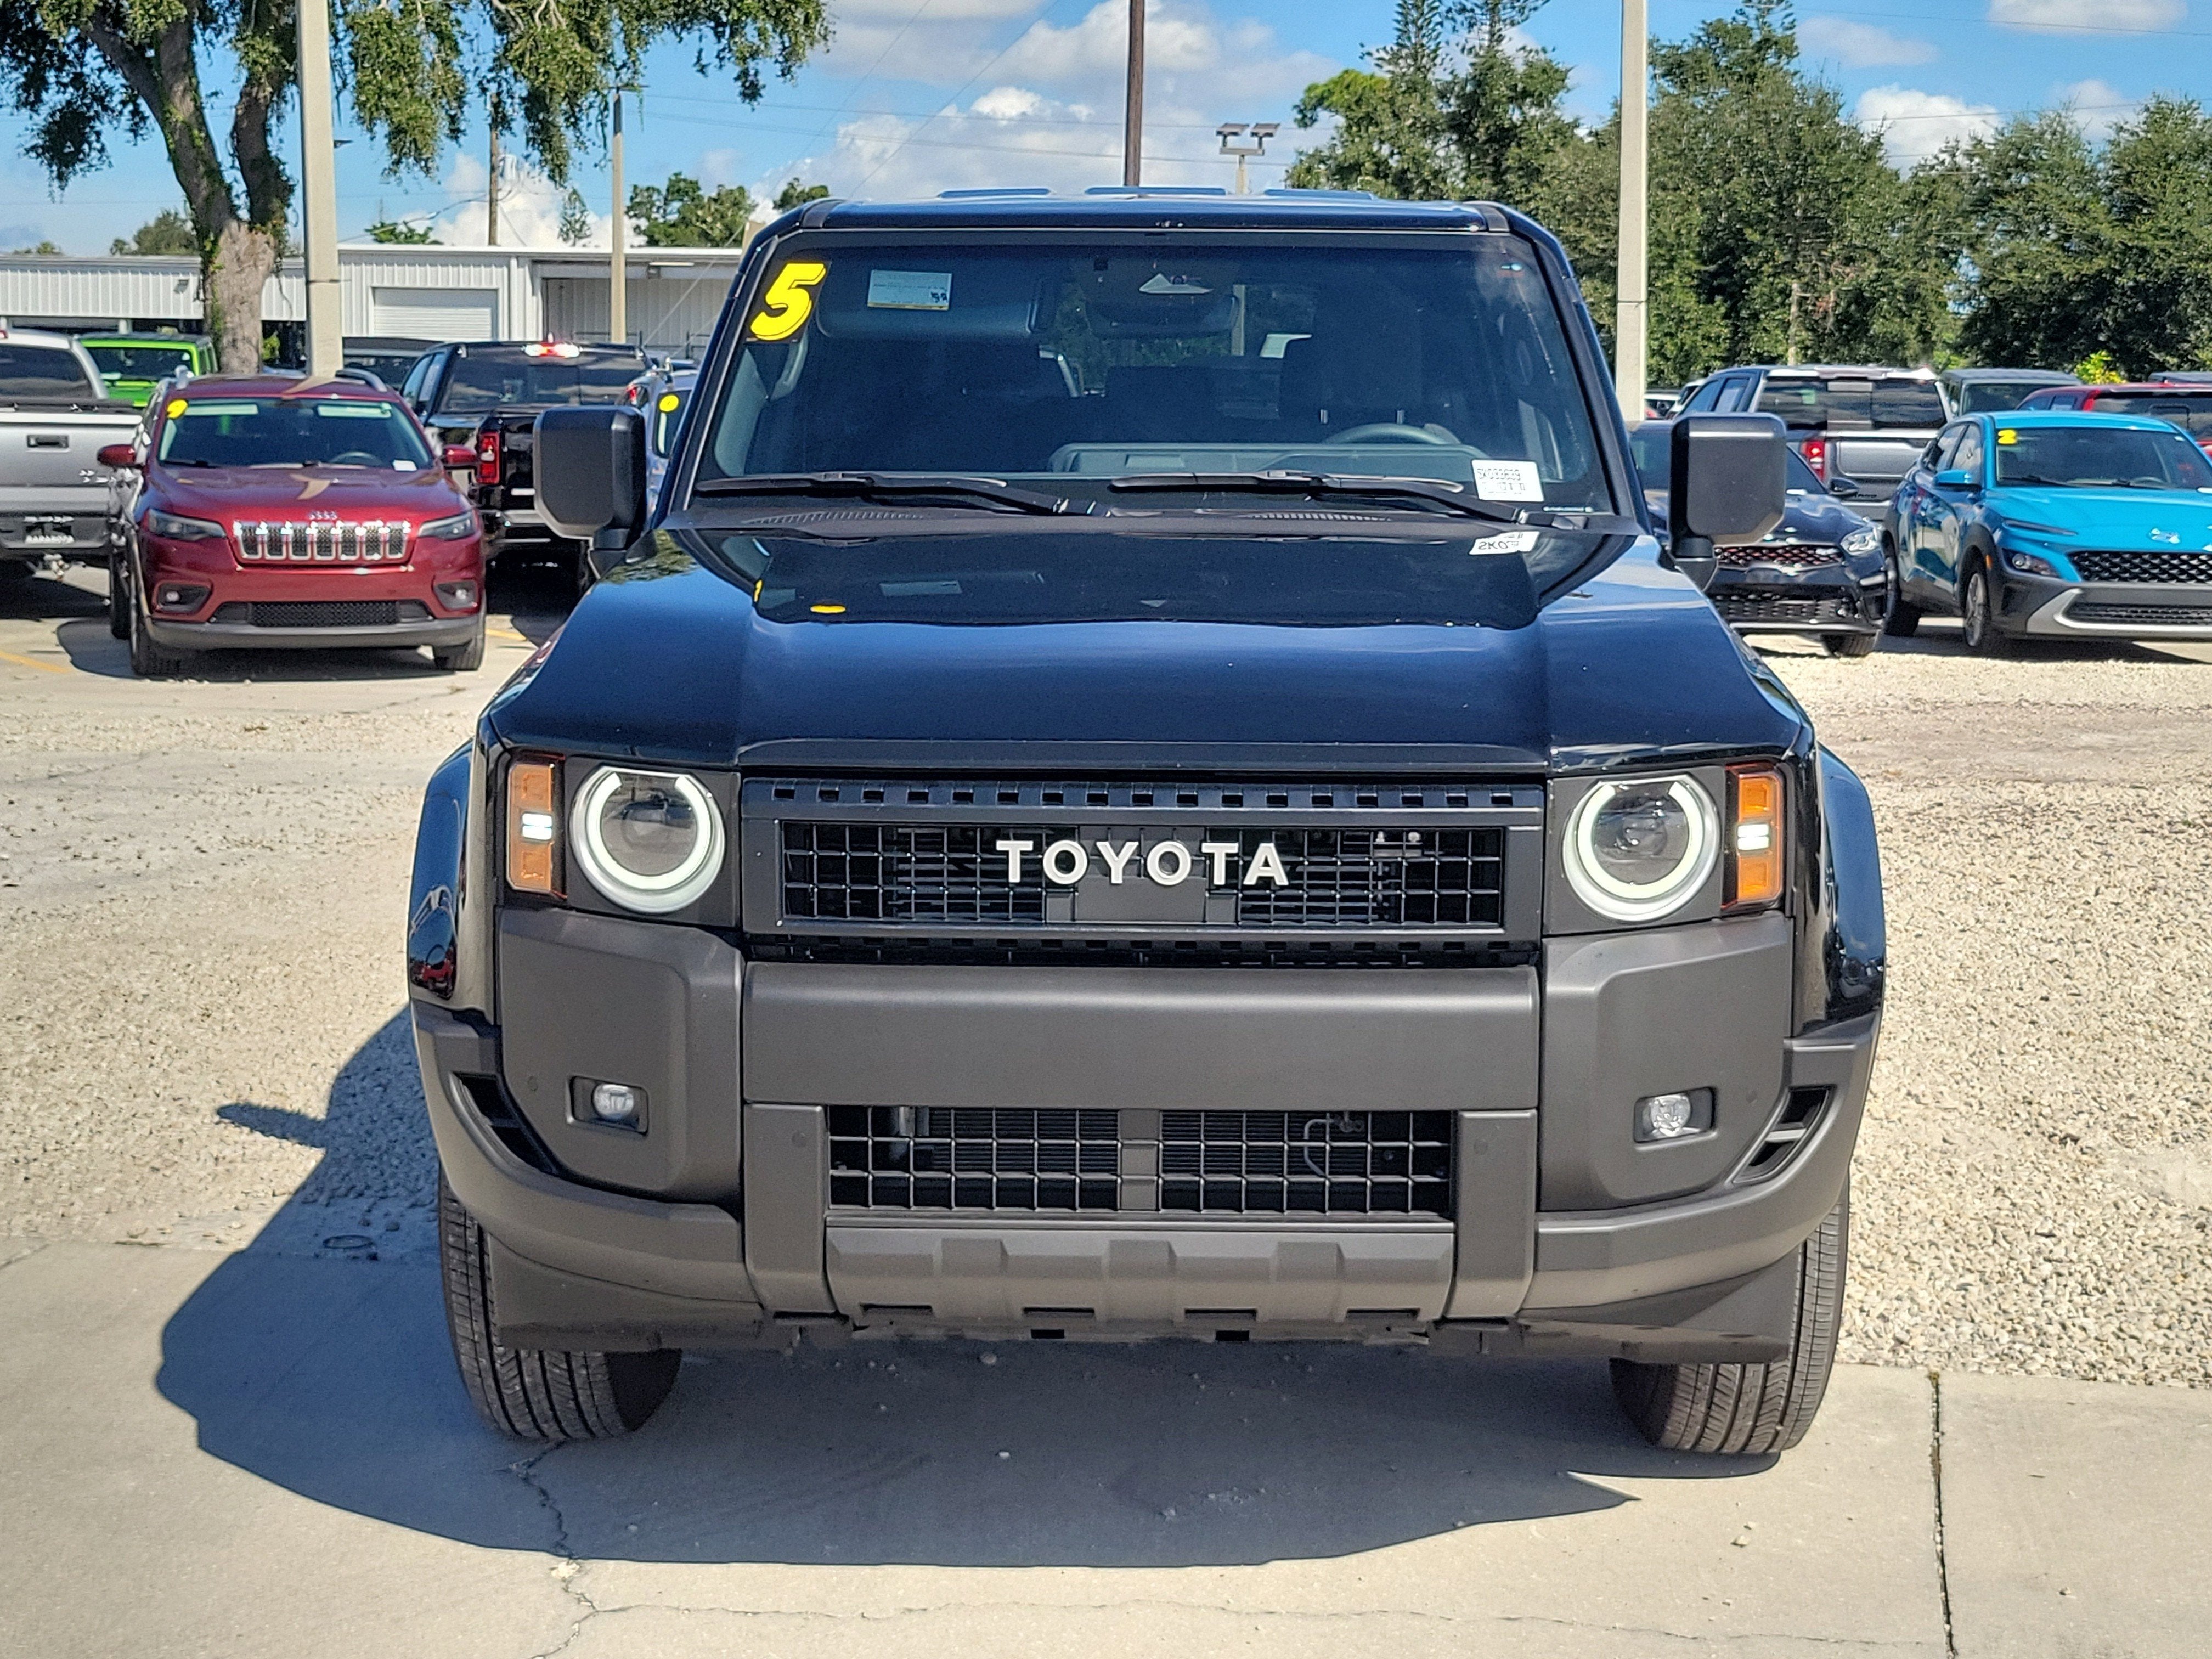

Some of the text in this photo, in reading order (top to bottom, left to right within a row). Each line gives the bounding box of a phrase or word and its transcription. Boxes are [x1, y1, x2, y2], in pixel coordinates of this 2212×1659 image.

[750, 263, 826, 341] 5
[1997, 430, 2016, 444] 2
[996, 839, 1289, 885] TOYOTA
